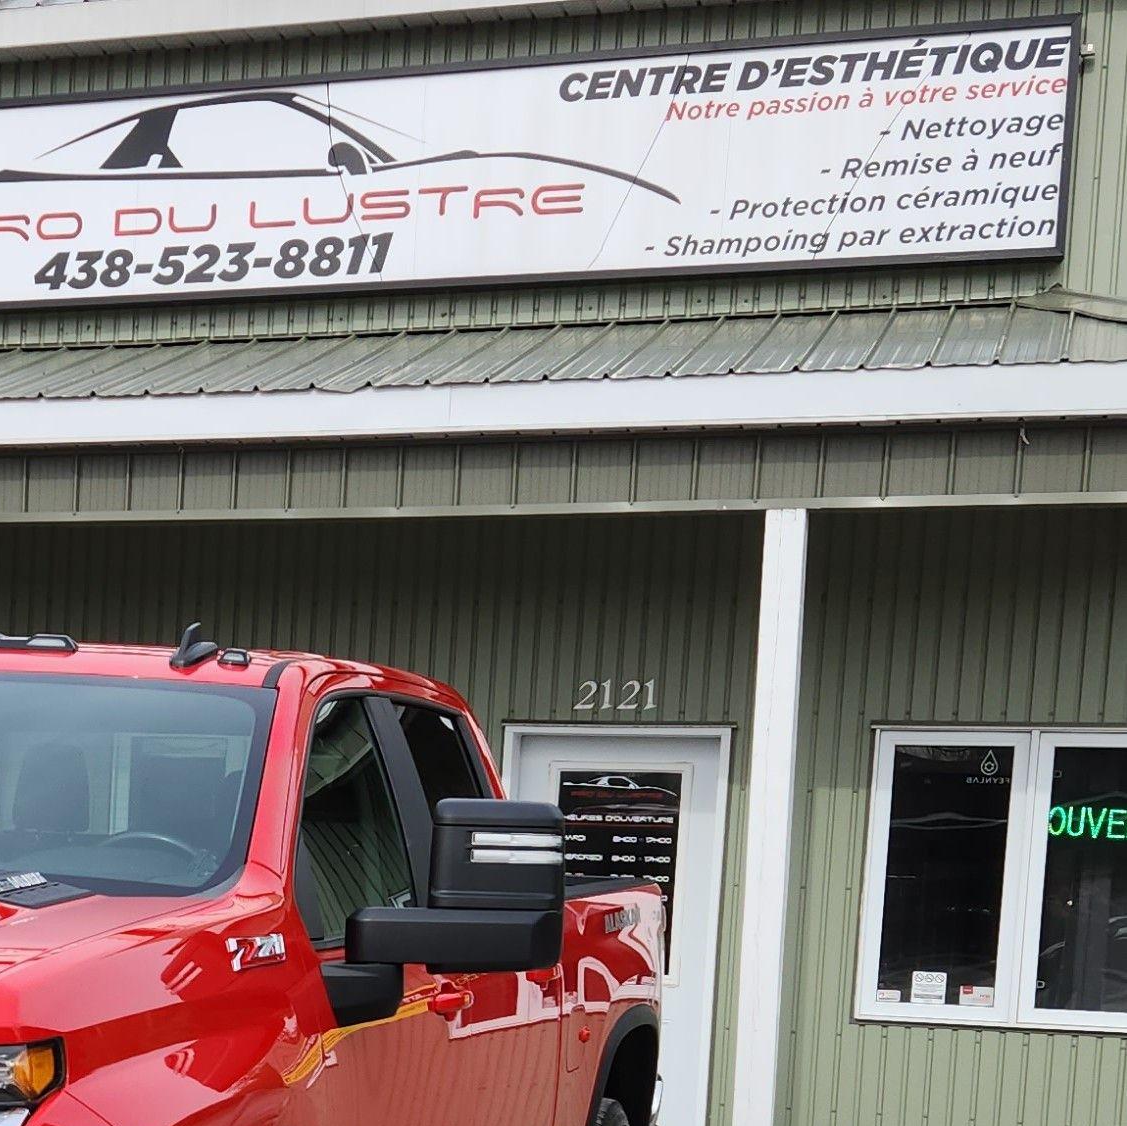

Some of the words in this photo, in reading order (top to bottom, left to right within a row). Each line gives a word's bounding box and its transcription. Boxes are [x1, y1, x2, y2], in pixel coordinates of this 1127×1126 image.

[559, 62, 731, 103] CENTRE
[665, 101, 740, 121] Notre
[747, 93, 850, 121] passion
[859, 87, 874, 109] à
[886, 82, 957, 107] votre
[967, 76, 1067, 101] service
[901, 111, 1064, 142] Nettoyage
[841, 154, 950, 180] Remise
[962, 147, 979, 171] à
[989, 143, 1062, 170] neuf
[114, 203, 217, 236] DU
[250, 185, 585, 229] LUSTRE
[729, 189, 885, 221] Protection
[897, 181, 1059, 210] céramique
[664, 229, 828, 257] Shampoing
[838, 228, 890, 254] par
[899, 216, 1055, 244] extraction
[35, 232, 394, 290] 438-523-8811
[574, 678, 658, 710] 2121
[1048, 806, 1127, 839] OUVE
[225, 932, 286, 971] Z71
